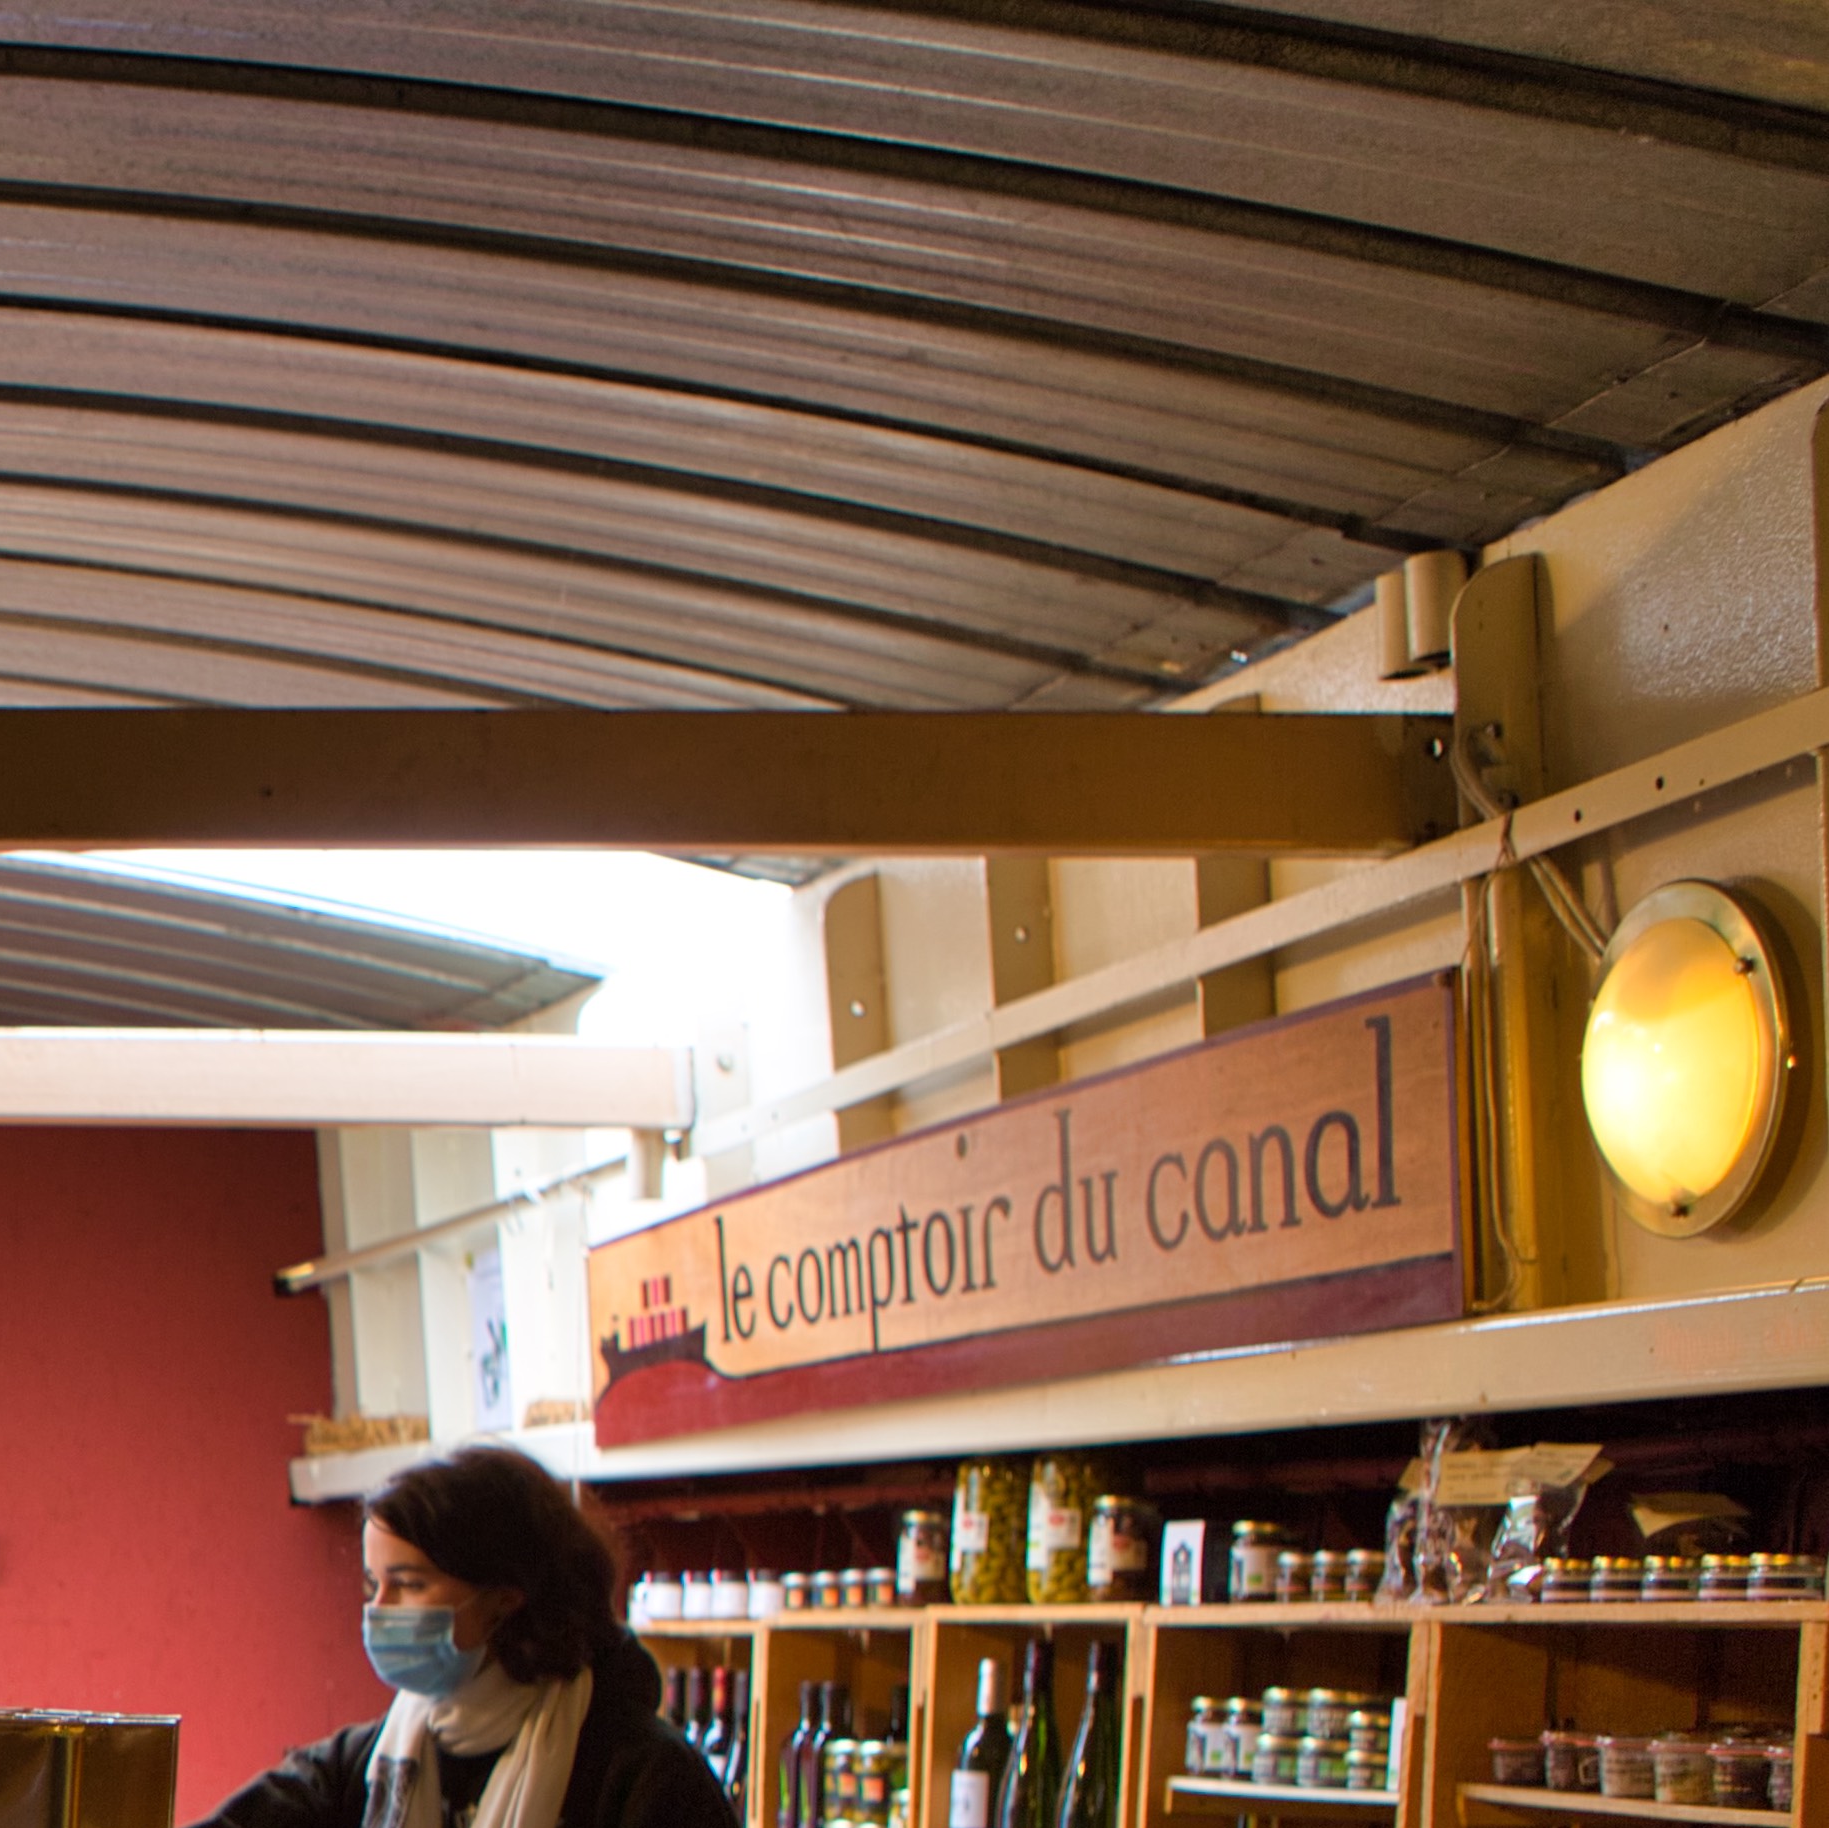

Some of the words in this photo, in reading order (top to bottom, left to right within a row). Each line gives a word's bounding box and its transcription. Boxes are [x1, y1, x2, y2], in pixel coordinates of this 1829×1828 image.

[713, 1214, 756, 1343] le
[766, 1140, 1011, 1353] comptoir
[1032, 1108, 1117, 1275] du
[1146, 1016, 1402, 1252] canal
